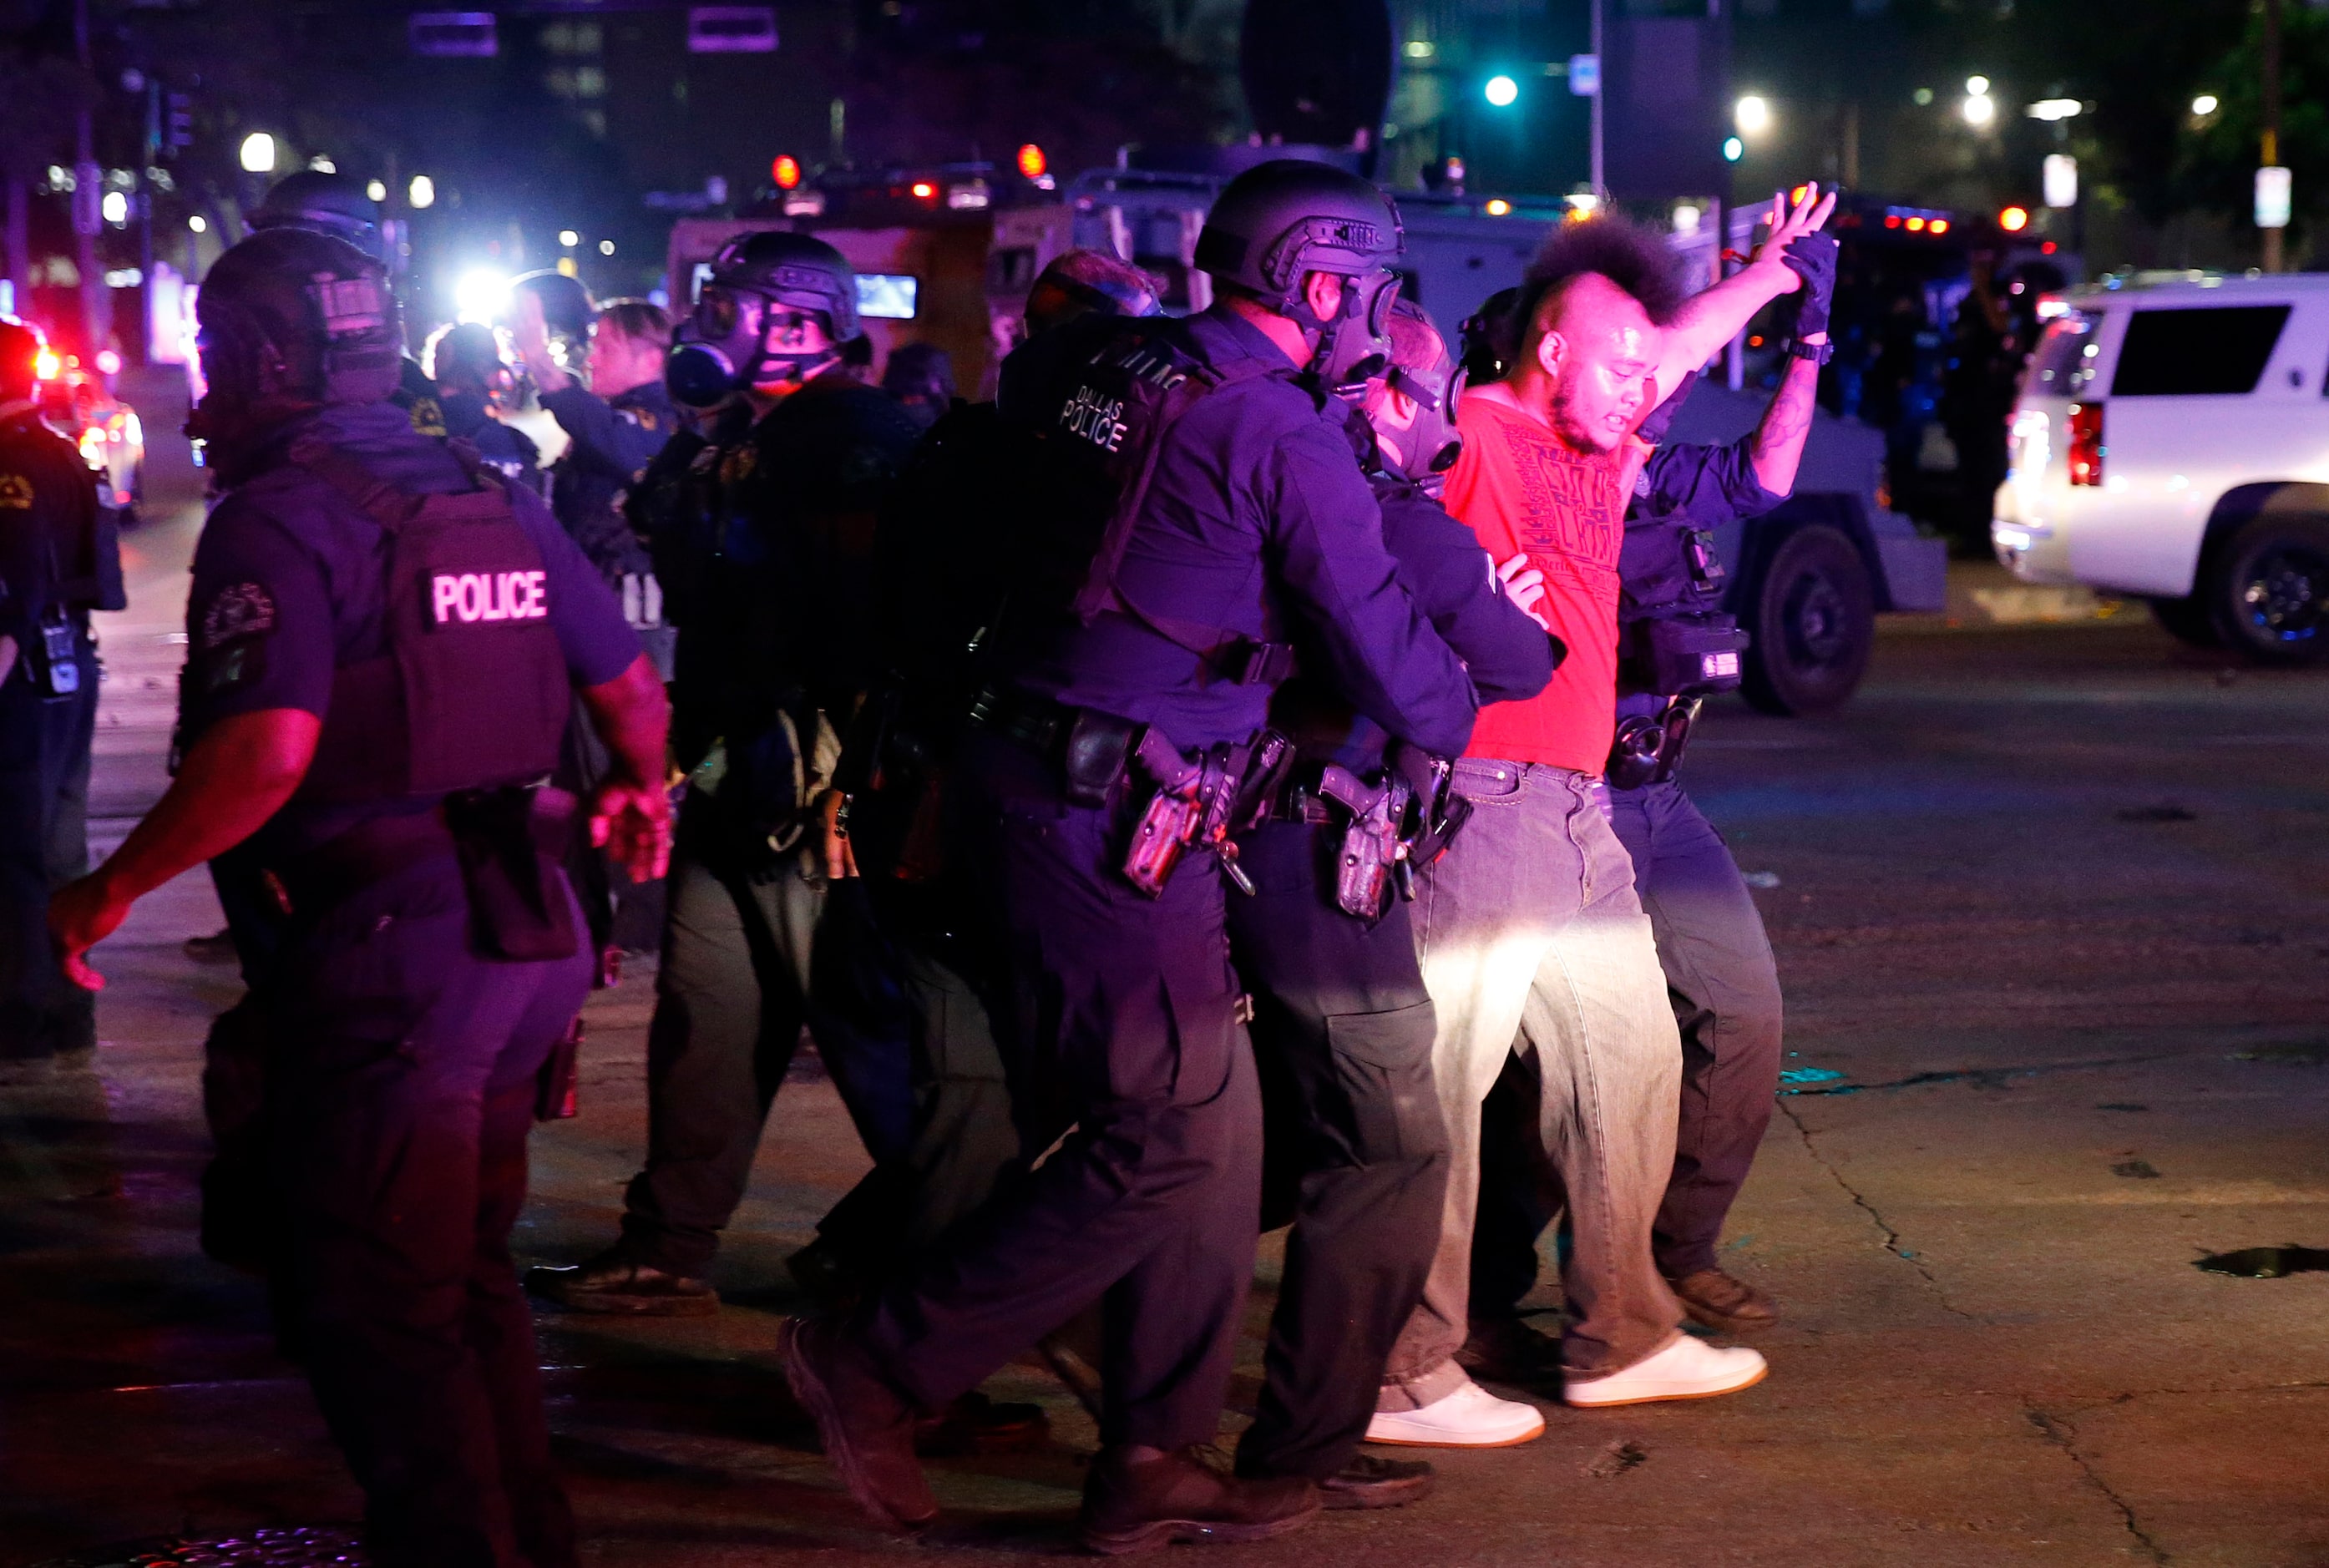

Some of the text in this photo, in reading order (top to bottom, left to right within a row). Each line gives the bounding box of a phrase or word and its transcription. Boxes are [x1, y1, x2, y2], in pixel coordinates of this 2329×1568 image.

[1059, 398, 1127, 452] POLICE
[1076, 385, 1123, 420] DALLAS
[433, 570, 547, 622] POLICE
